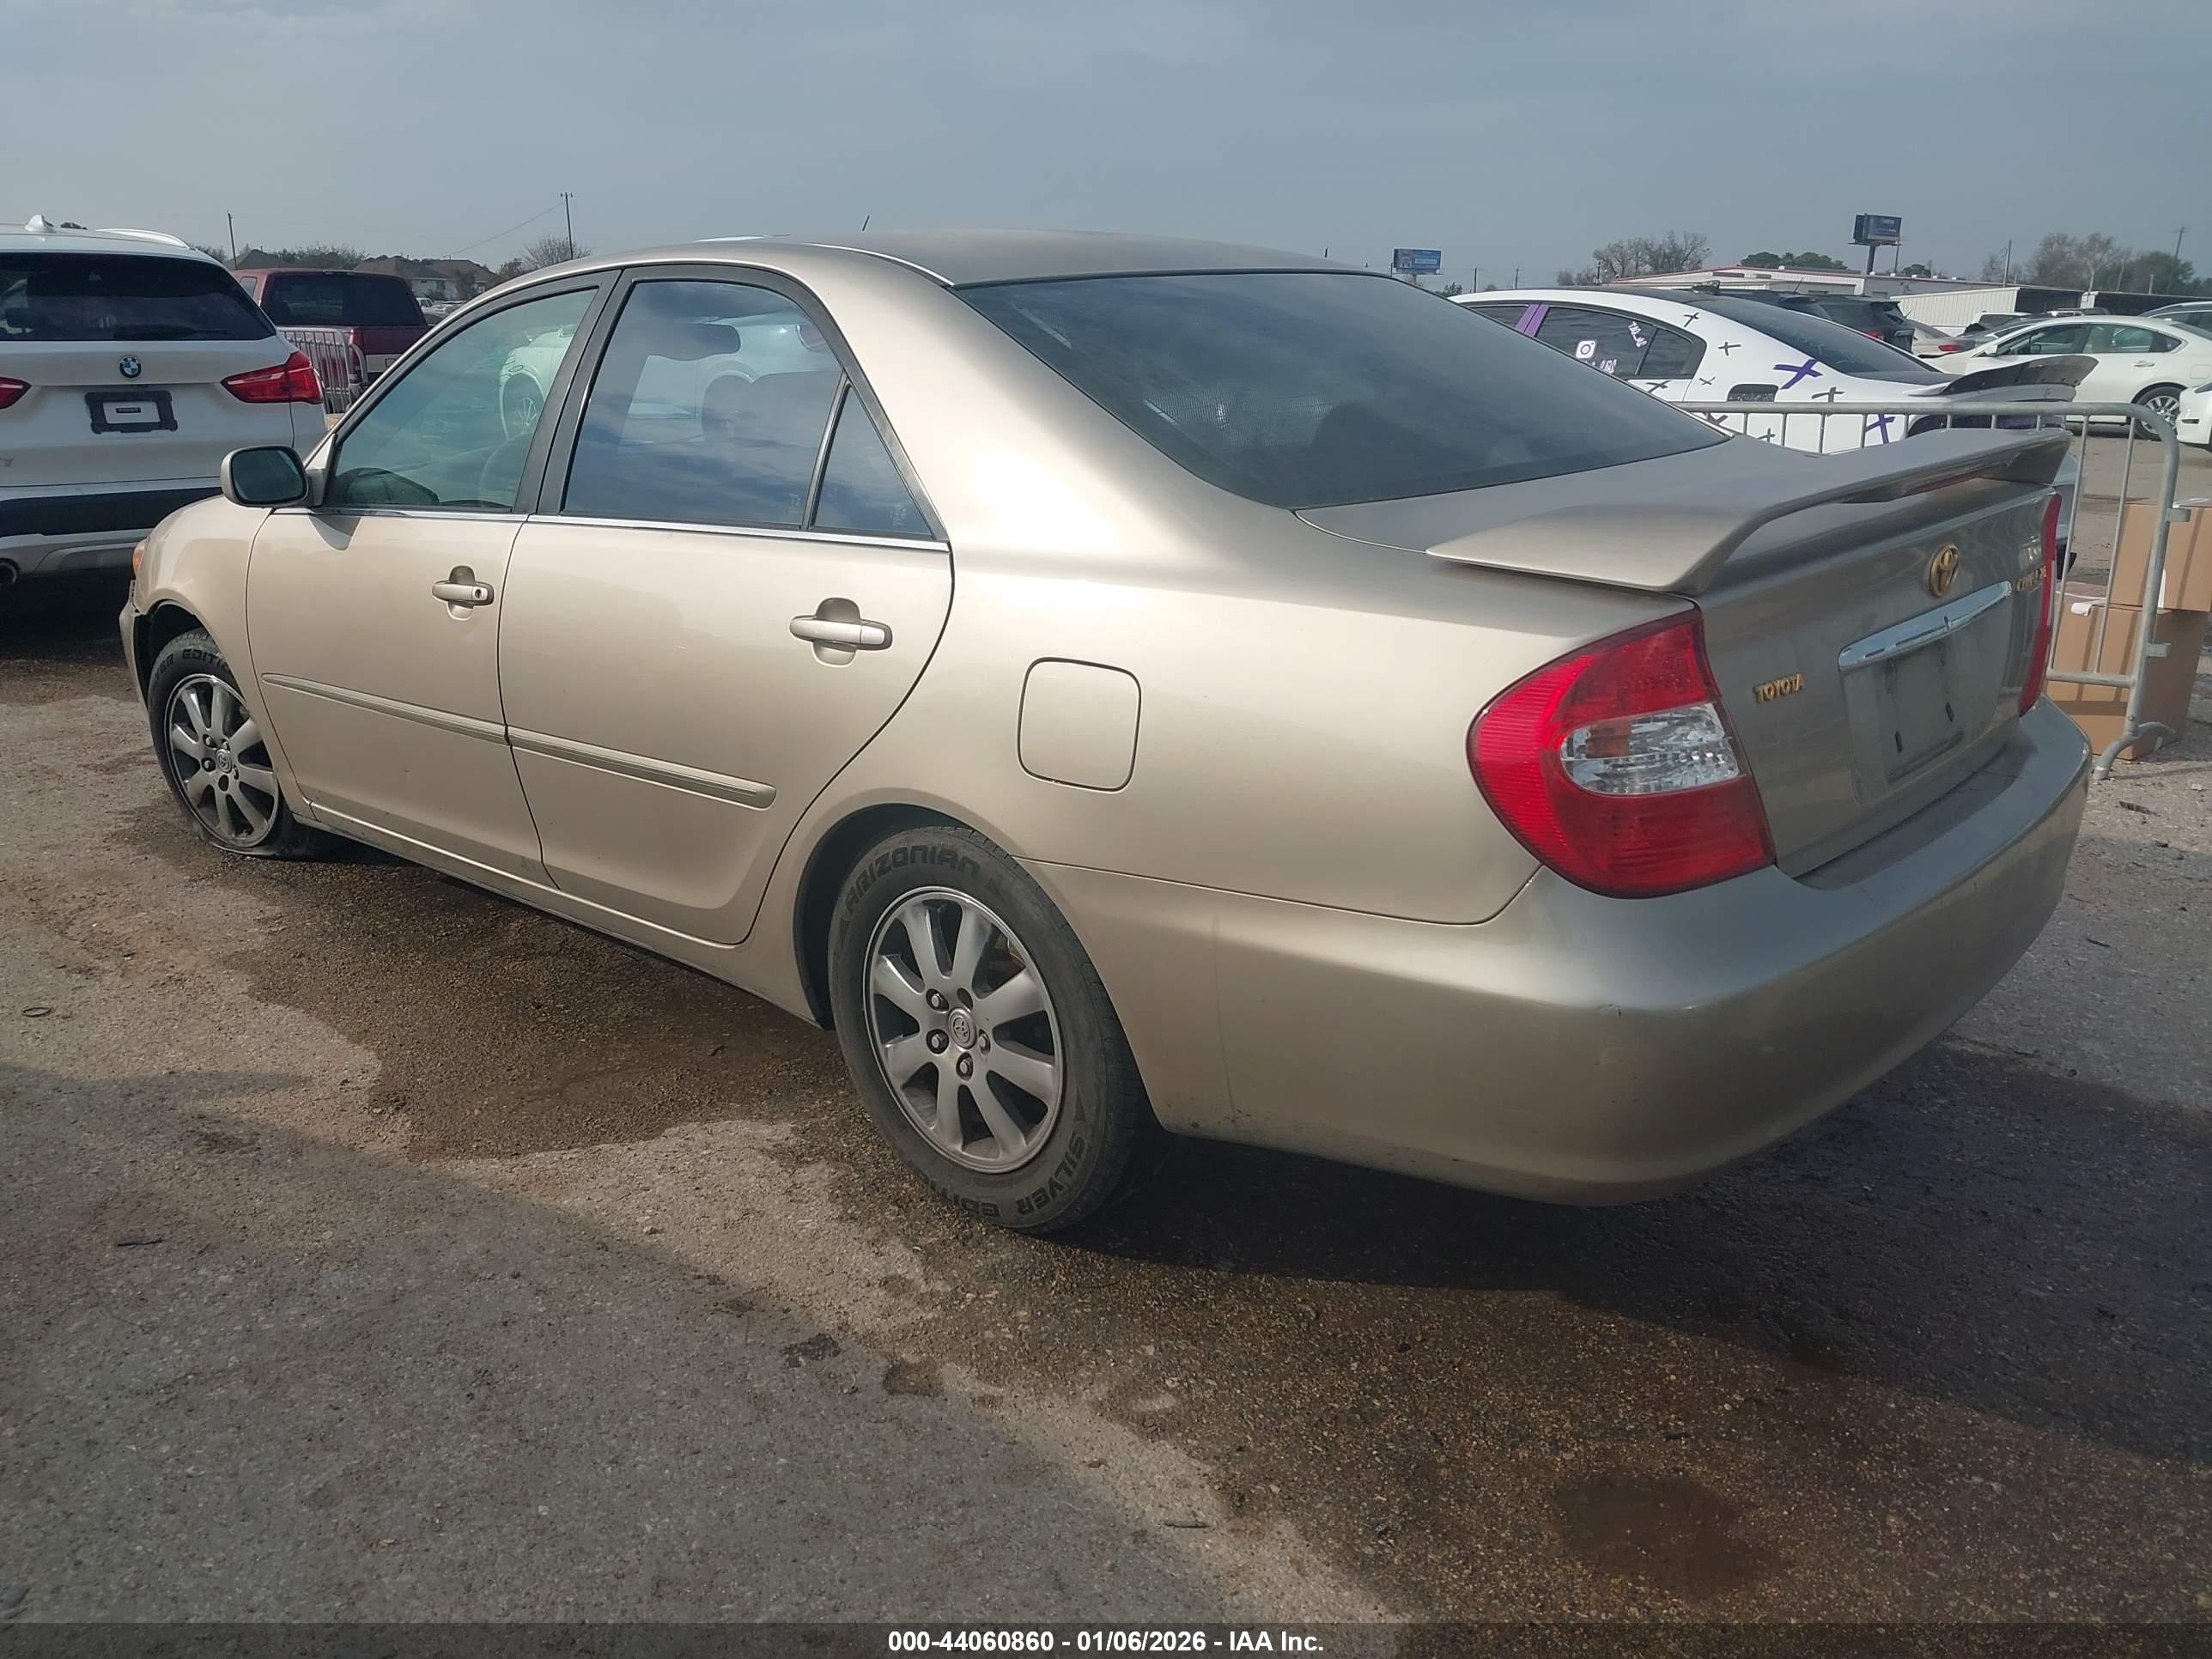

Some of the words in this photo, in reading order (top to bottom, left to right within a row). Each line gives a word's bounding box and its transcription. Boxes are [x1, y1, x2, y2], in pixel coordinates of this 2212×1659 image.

[1753, 673, 1805, 702] TOYOTA
[845, 845, 981, 915] ARIZONIAN
[1016, 1132, 1085, 1216] SILVER
